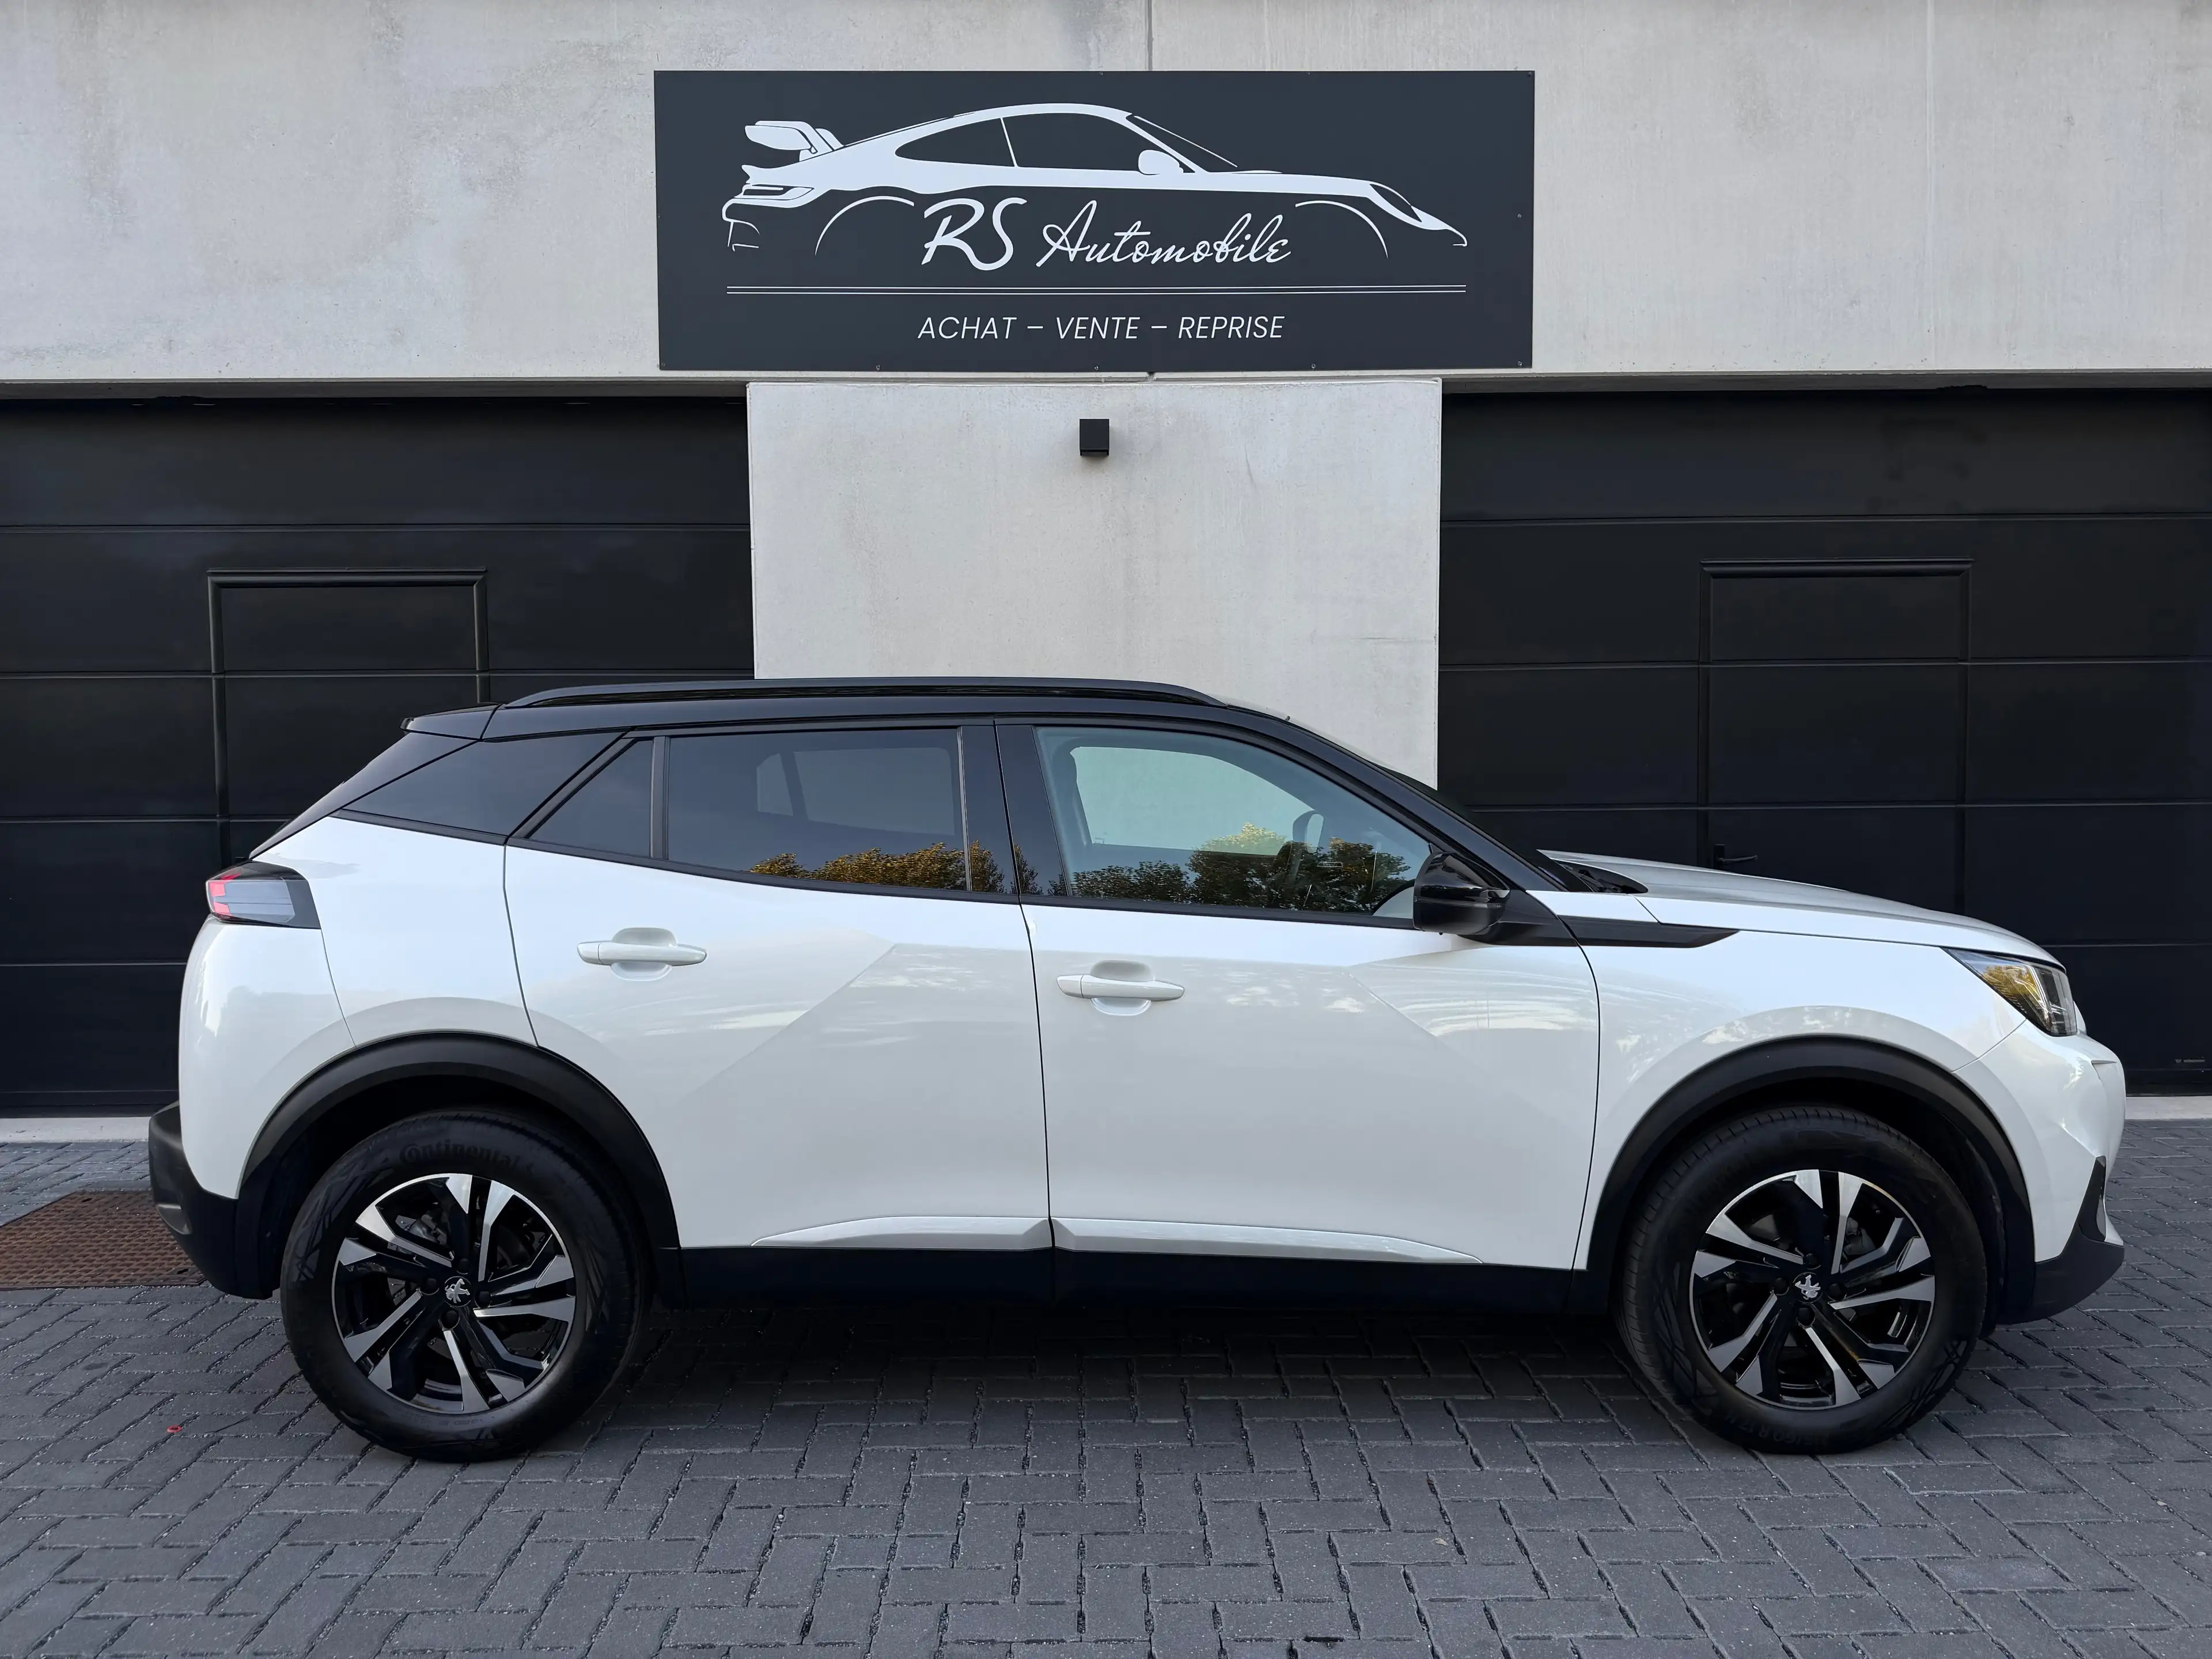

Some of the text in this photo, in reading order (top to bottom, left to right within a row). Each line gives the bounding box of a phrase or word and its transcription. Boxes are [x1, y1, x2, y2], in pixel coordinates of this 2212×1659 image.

[922, 198, 1291, 270] RS Automobile
[918, 317, 1017, 339] ACHAT
[1056, 317, 1141, 339] VENTE
[1179, 316, 1286, 339] REPRISE
[400, 1139, 521, 1166] Continental
